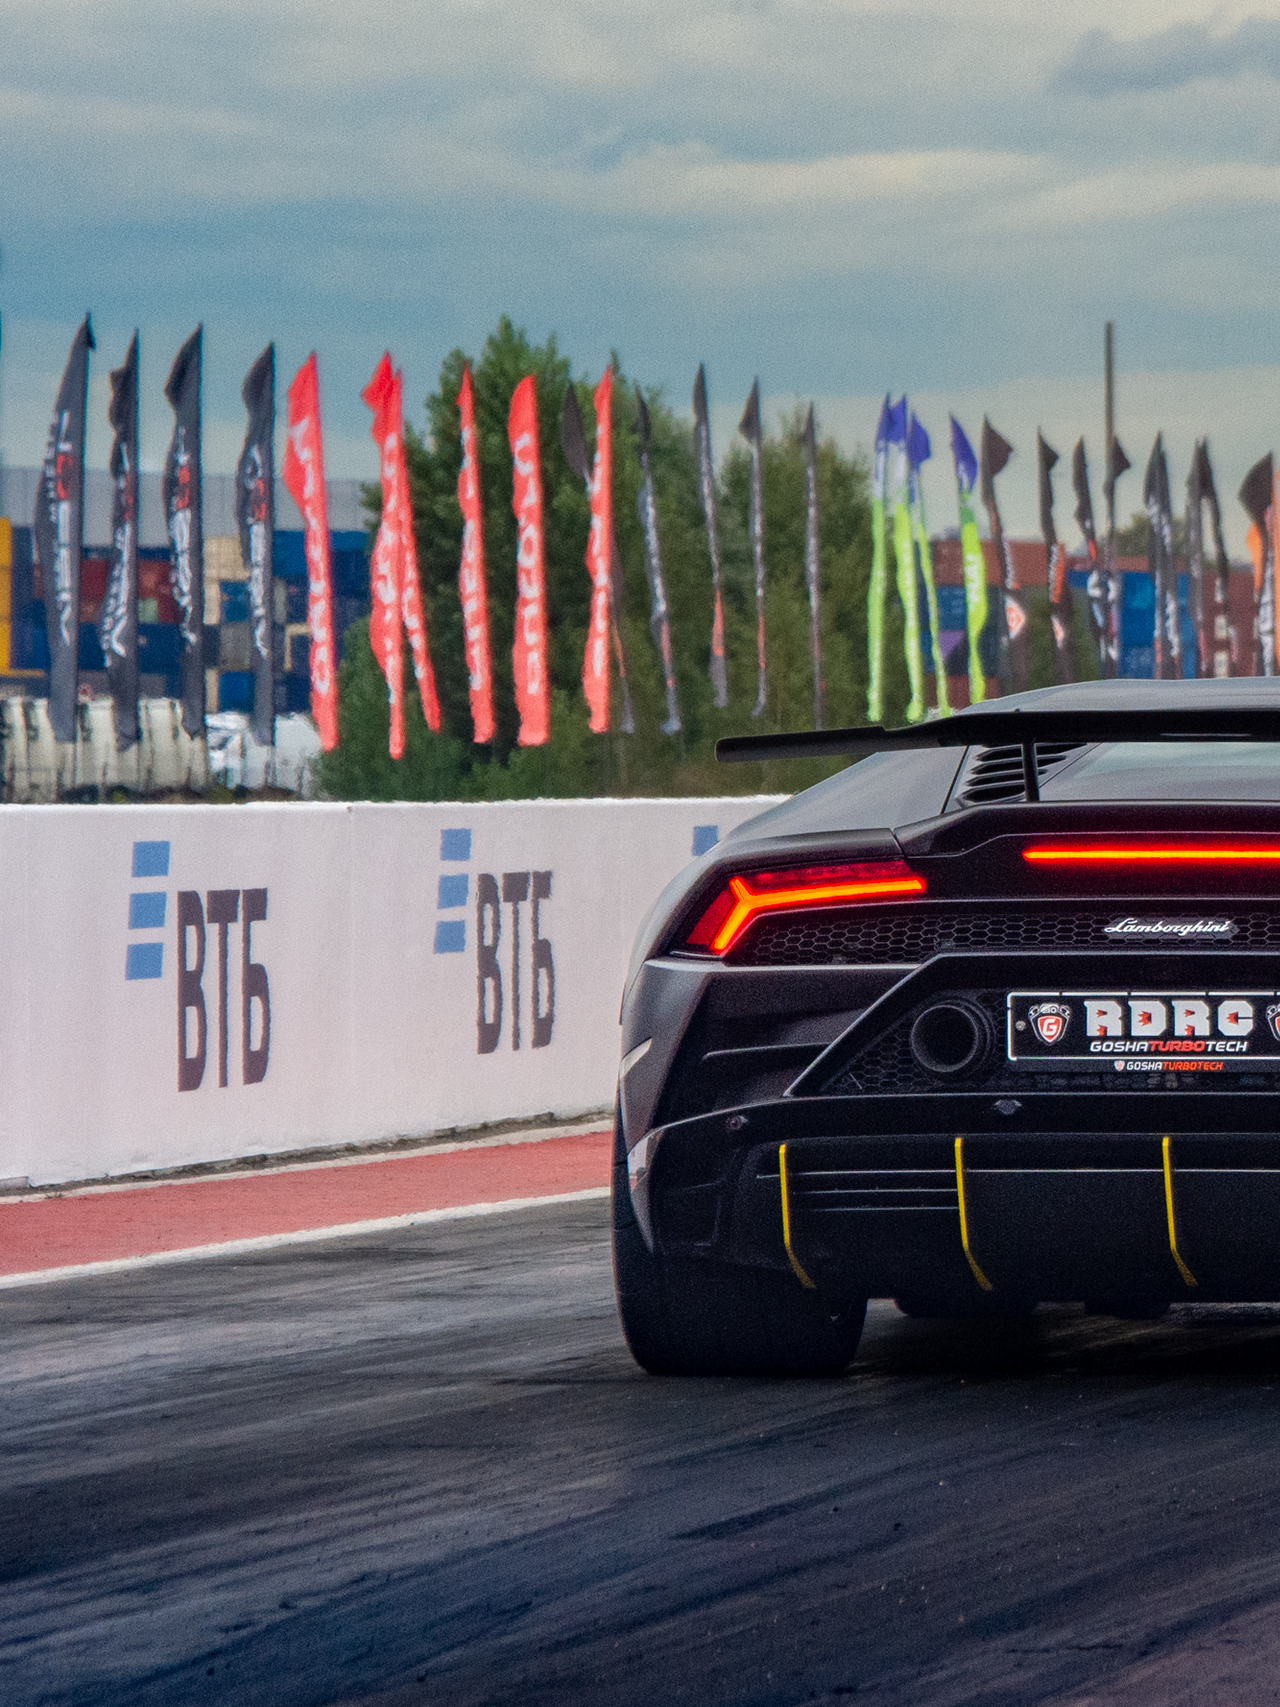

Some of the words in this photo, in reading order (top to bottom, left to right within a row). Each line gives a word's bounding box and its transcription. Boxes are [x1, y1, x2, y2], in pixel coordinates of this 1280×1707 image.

[1104, 917, 1231, 936] Lamborghini
[476, 870, 556, 1055] ВТБ
[177, 888, 271, 1092] ВТБ
[1084, 1000, 1253, 1037] RDRC
[1090, 1040, 1248, 1052] GOSHATURBOTECH
[1126, 1061, 1224, 1071] GOSHATURBOTECH
